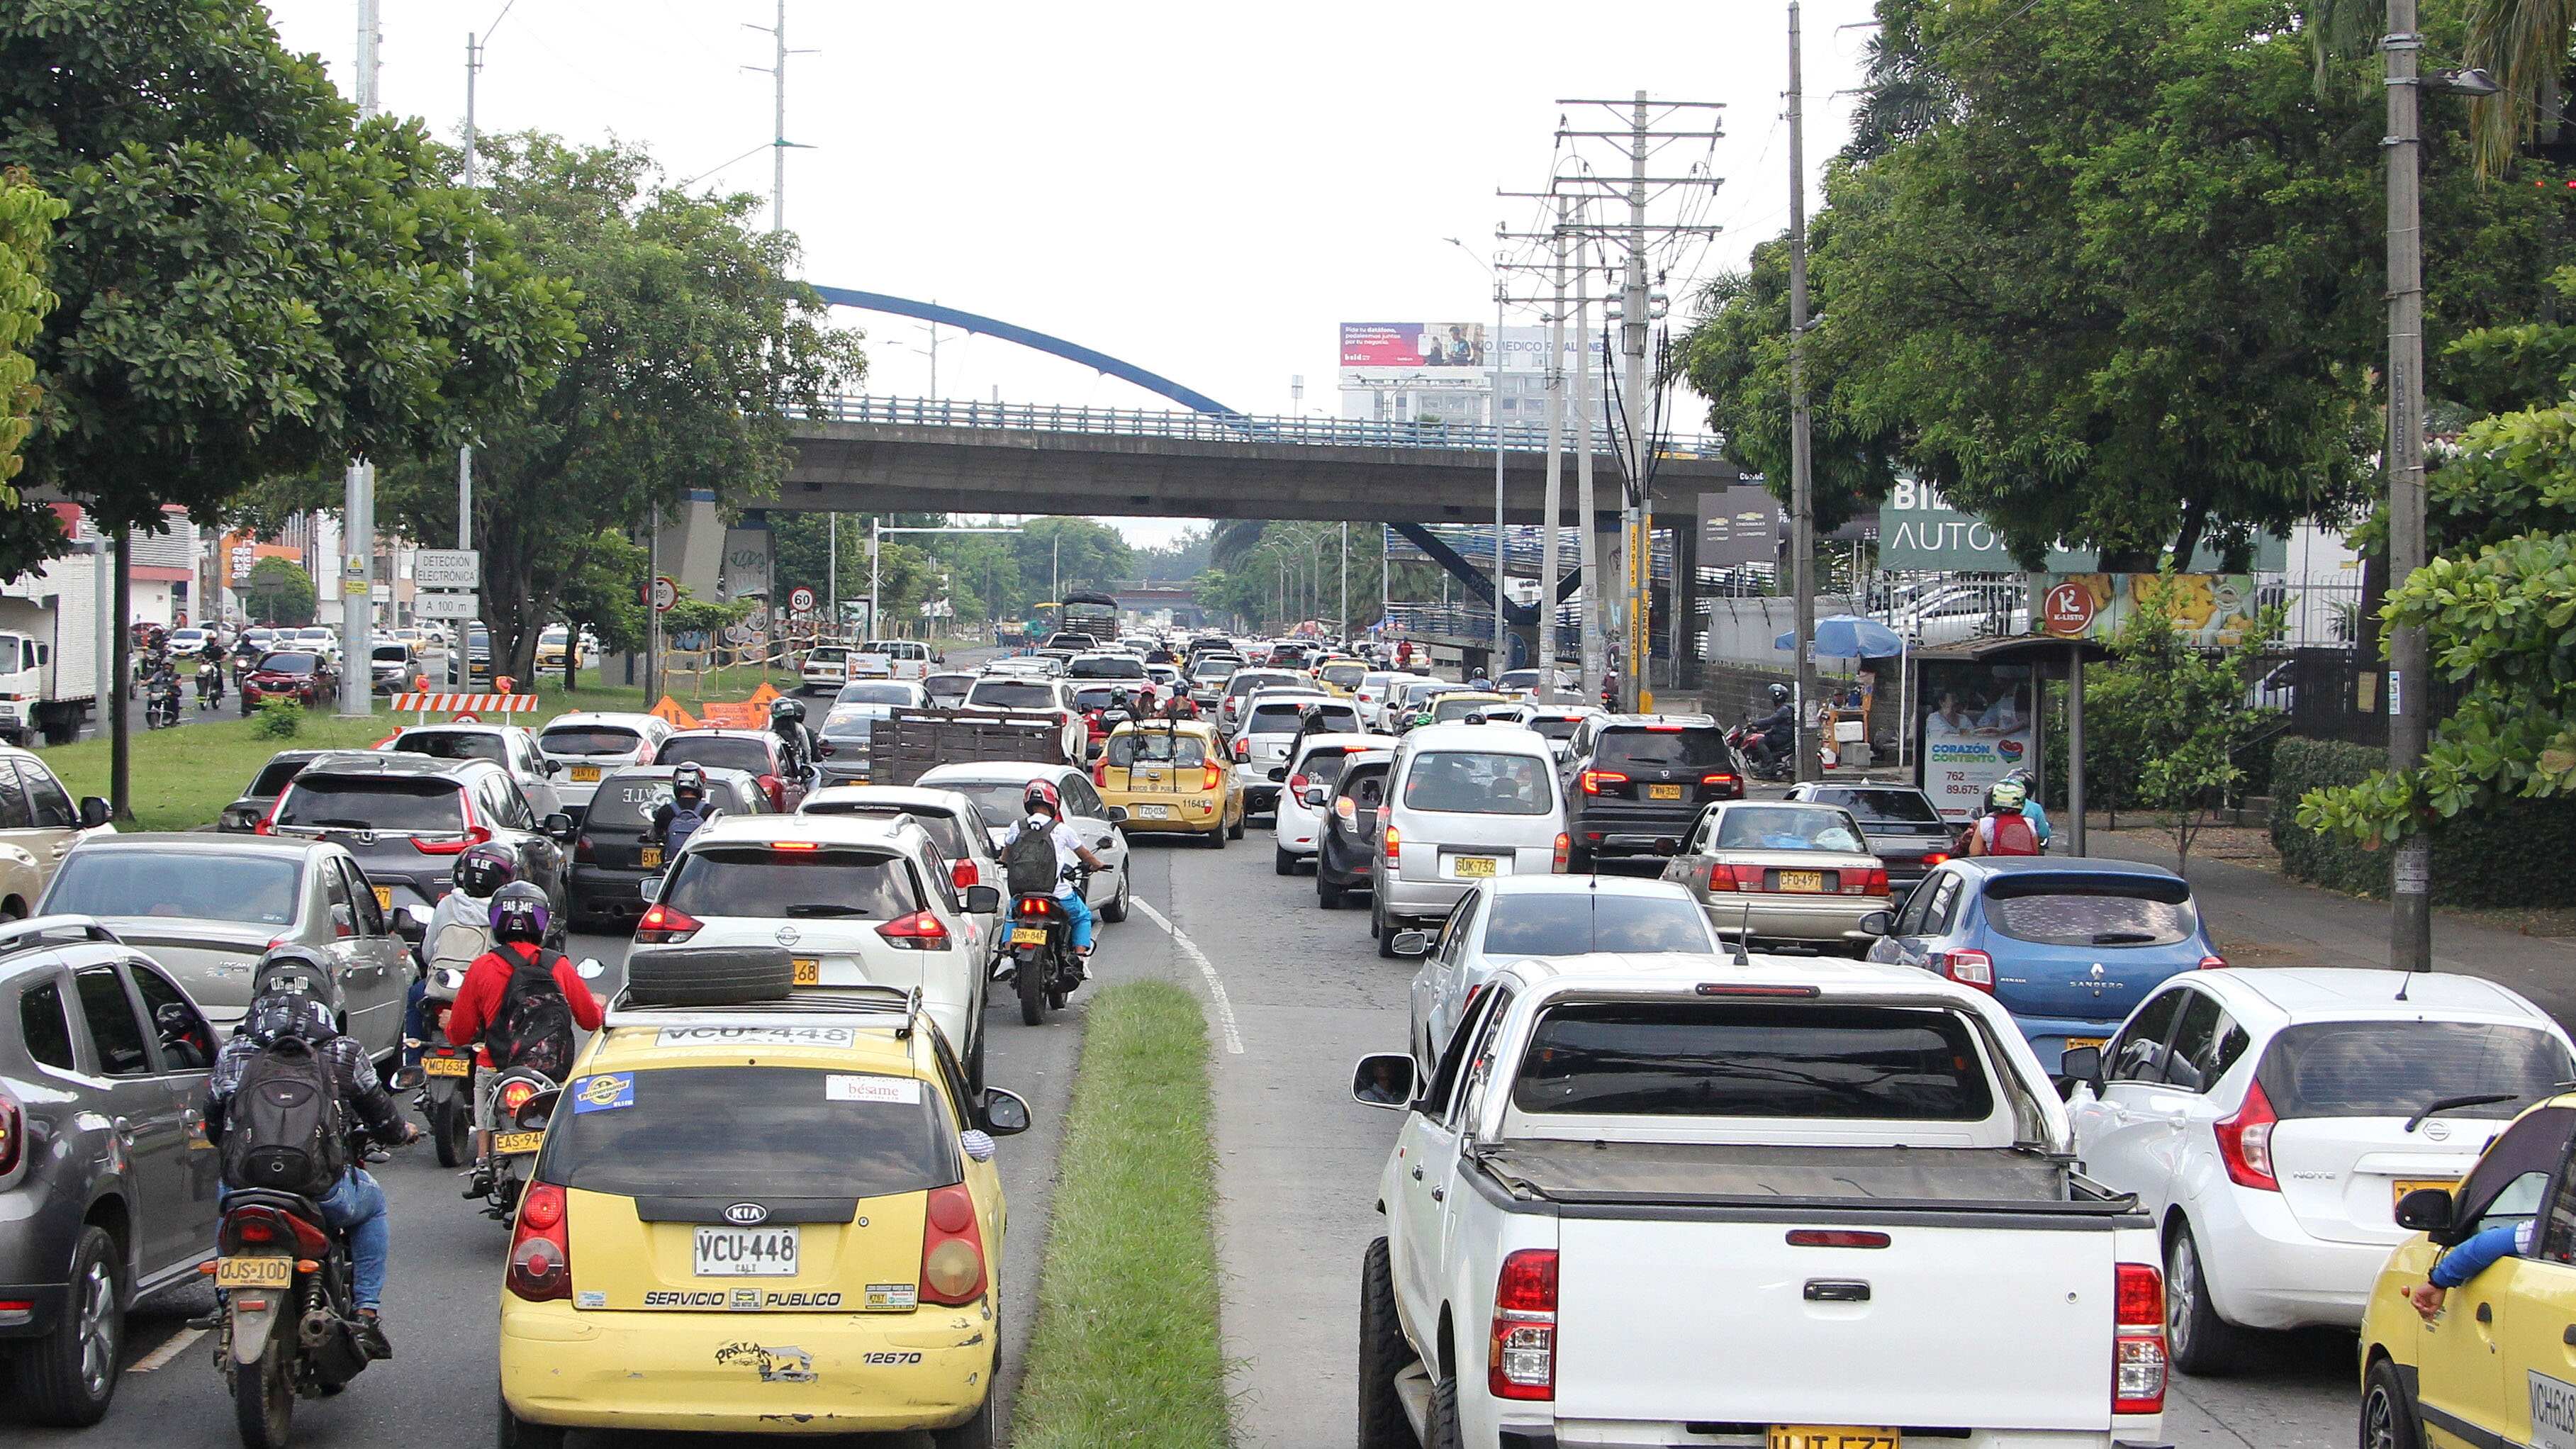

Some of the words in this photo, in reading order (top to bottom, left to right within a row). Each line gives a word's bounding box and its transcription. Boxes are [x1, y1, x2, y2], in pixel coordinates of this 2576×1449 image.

[794, 595, 810, 606] 60
[426, 601, 433, 611] A
[437, 601, 454, 612] 100
[2053, 613, 2085, 622] K-LISTO
[1932, 742, 1990, 754] CORAZÓN
[1932, 754, 1997, 763] CONTENTO
[1946, 771, 1965, 781] 762
[1946, 784, 1980, 795] 89.675
[1182, 799, 1206, 809] 11643
[502, 900, 516, 912] EAS
[2069, 980, 2124, 989] SANDERO
[848, 1082, 900, 1096] bésame
[2293, 1170, 2336, 1180] NOTE
[732, 1208, 761, 1219] KIA
[734, 1263, 757, 1272] CALI
[644, 1292, 725, 1306] SERVICIO
[765, 1292, 842, 1307] PUBLICO
[863, 1352, 922, 1364] 12670
